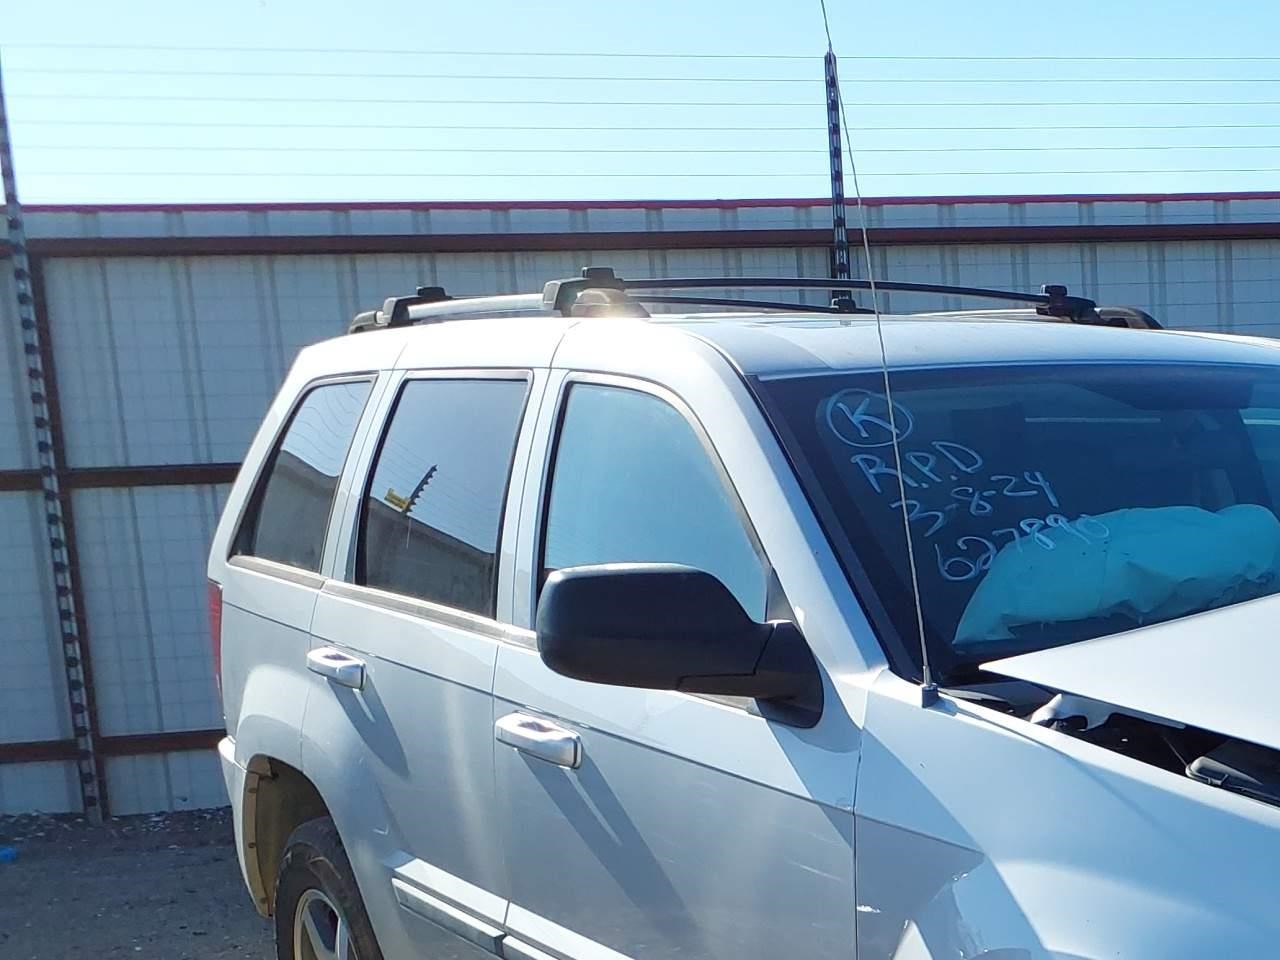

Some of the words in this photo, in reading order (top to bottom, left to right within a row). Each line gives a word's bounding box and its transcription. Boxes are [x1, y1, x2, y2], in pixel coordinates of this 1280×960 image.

[835, 396, 901, 440] K
[889, 471, 1059, 538] 3-8-24
[935, 513, 1110, 581] 627890
